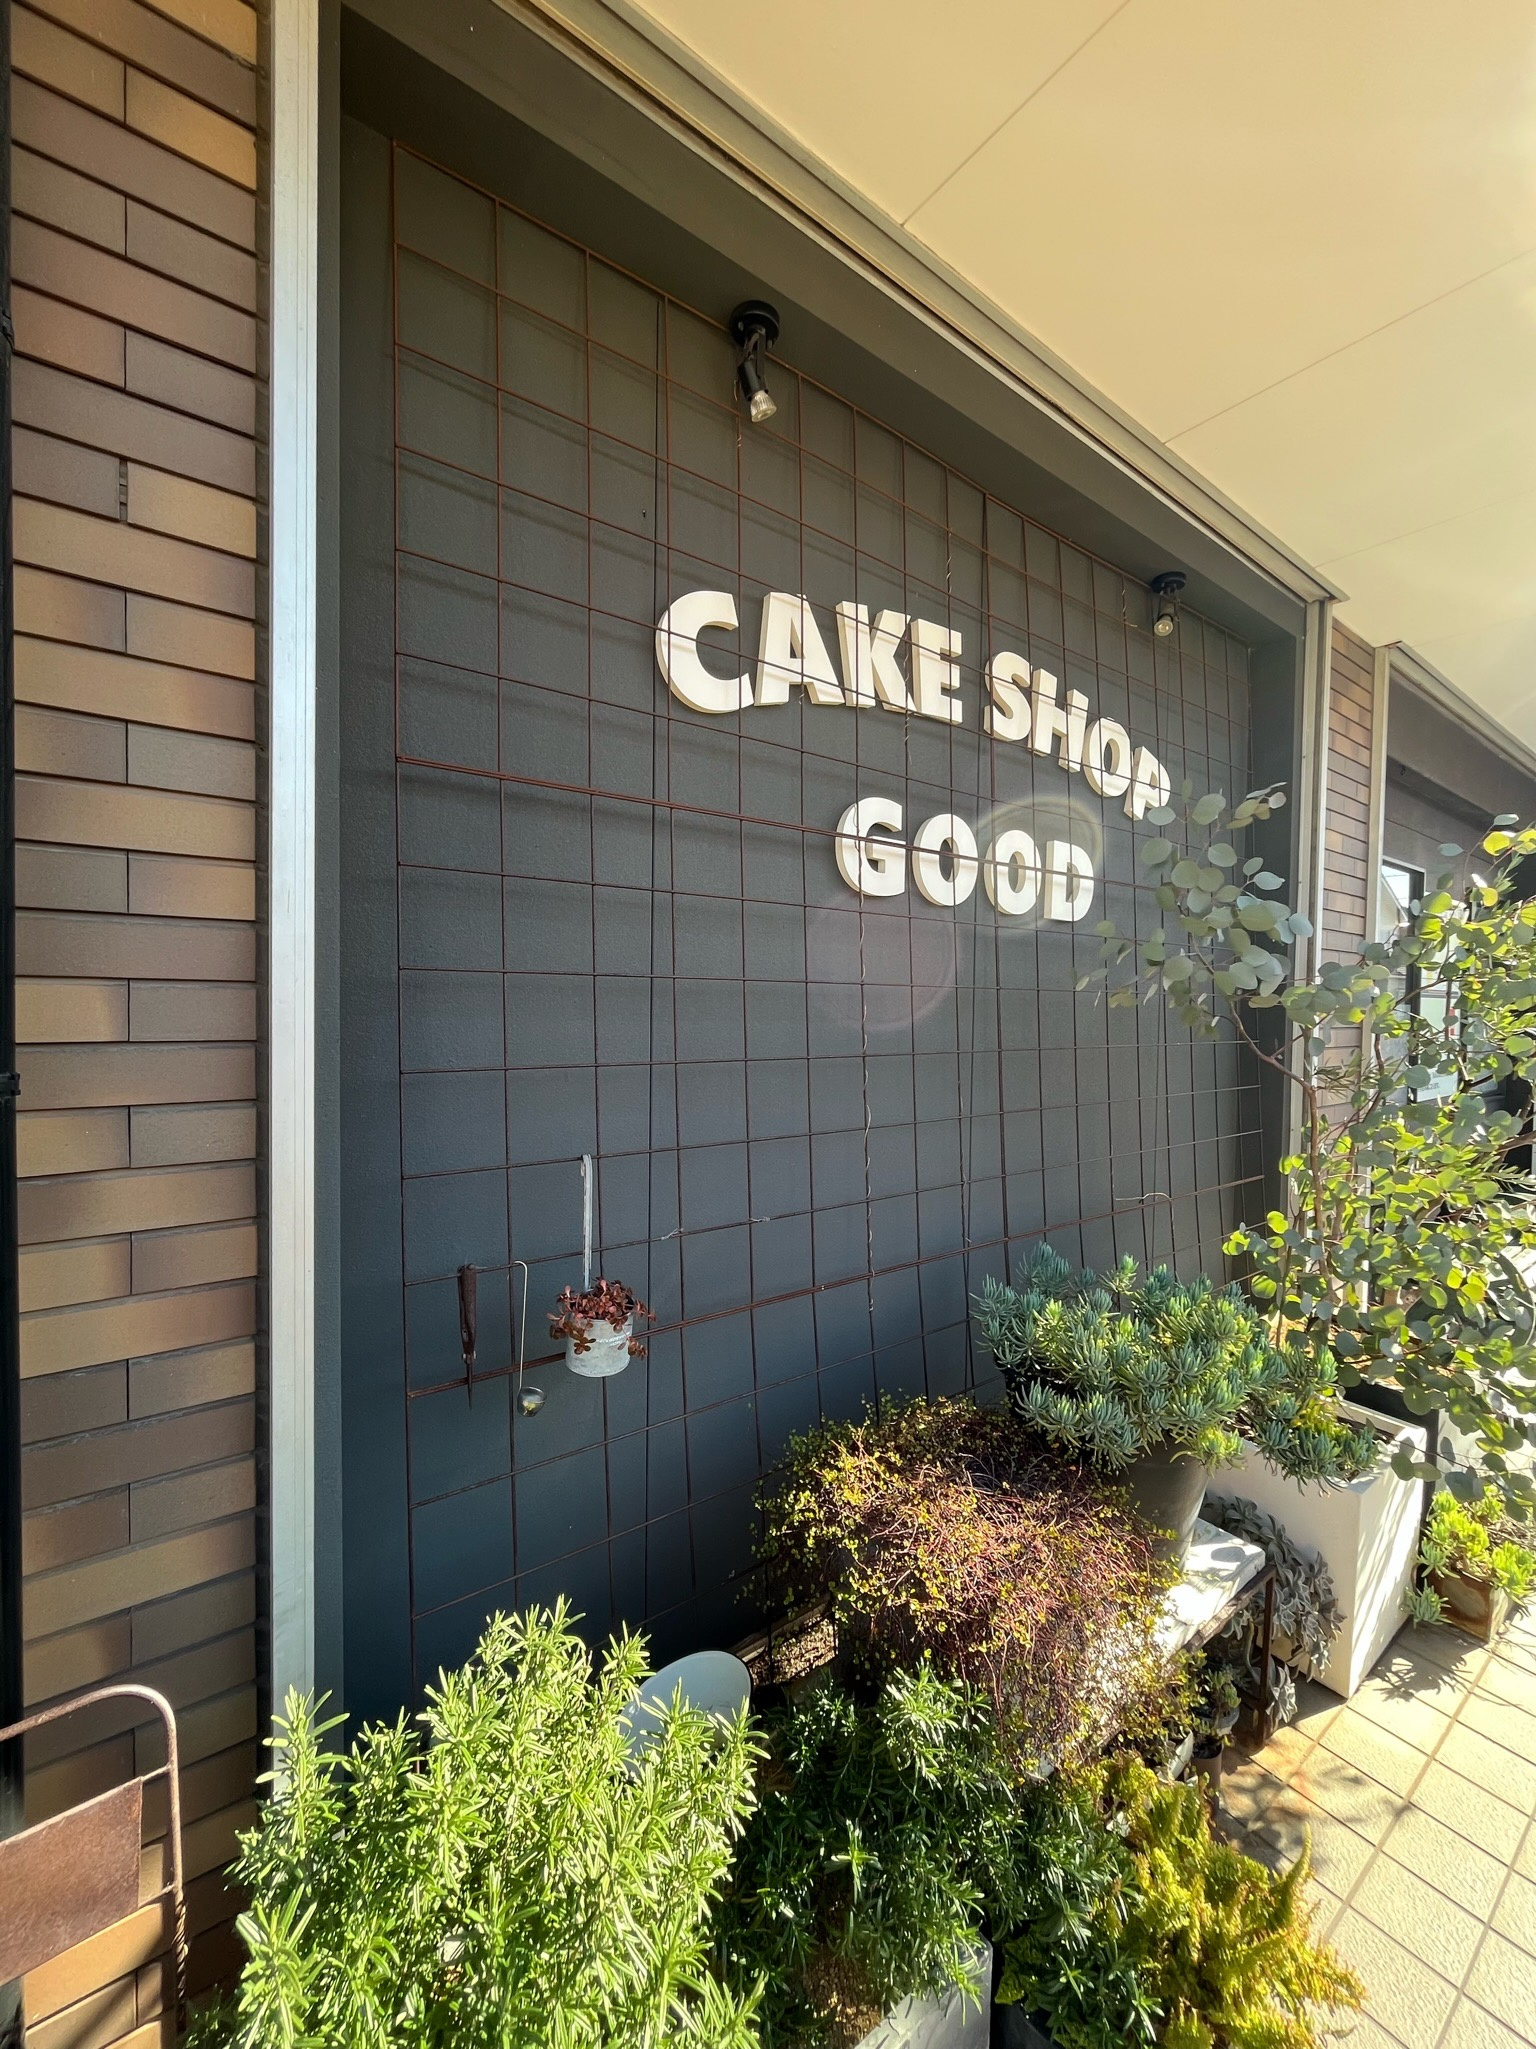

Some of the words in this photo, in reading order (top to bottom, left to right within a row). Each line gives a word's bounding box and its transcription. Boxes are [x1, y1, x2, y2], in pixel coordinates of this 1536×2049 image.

[656, 591, 963, 723] CAKE
[984, 651, 1171, 821] SHOP
[835, 797, 1094, 922] GOOD
